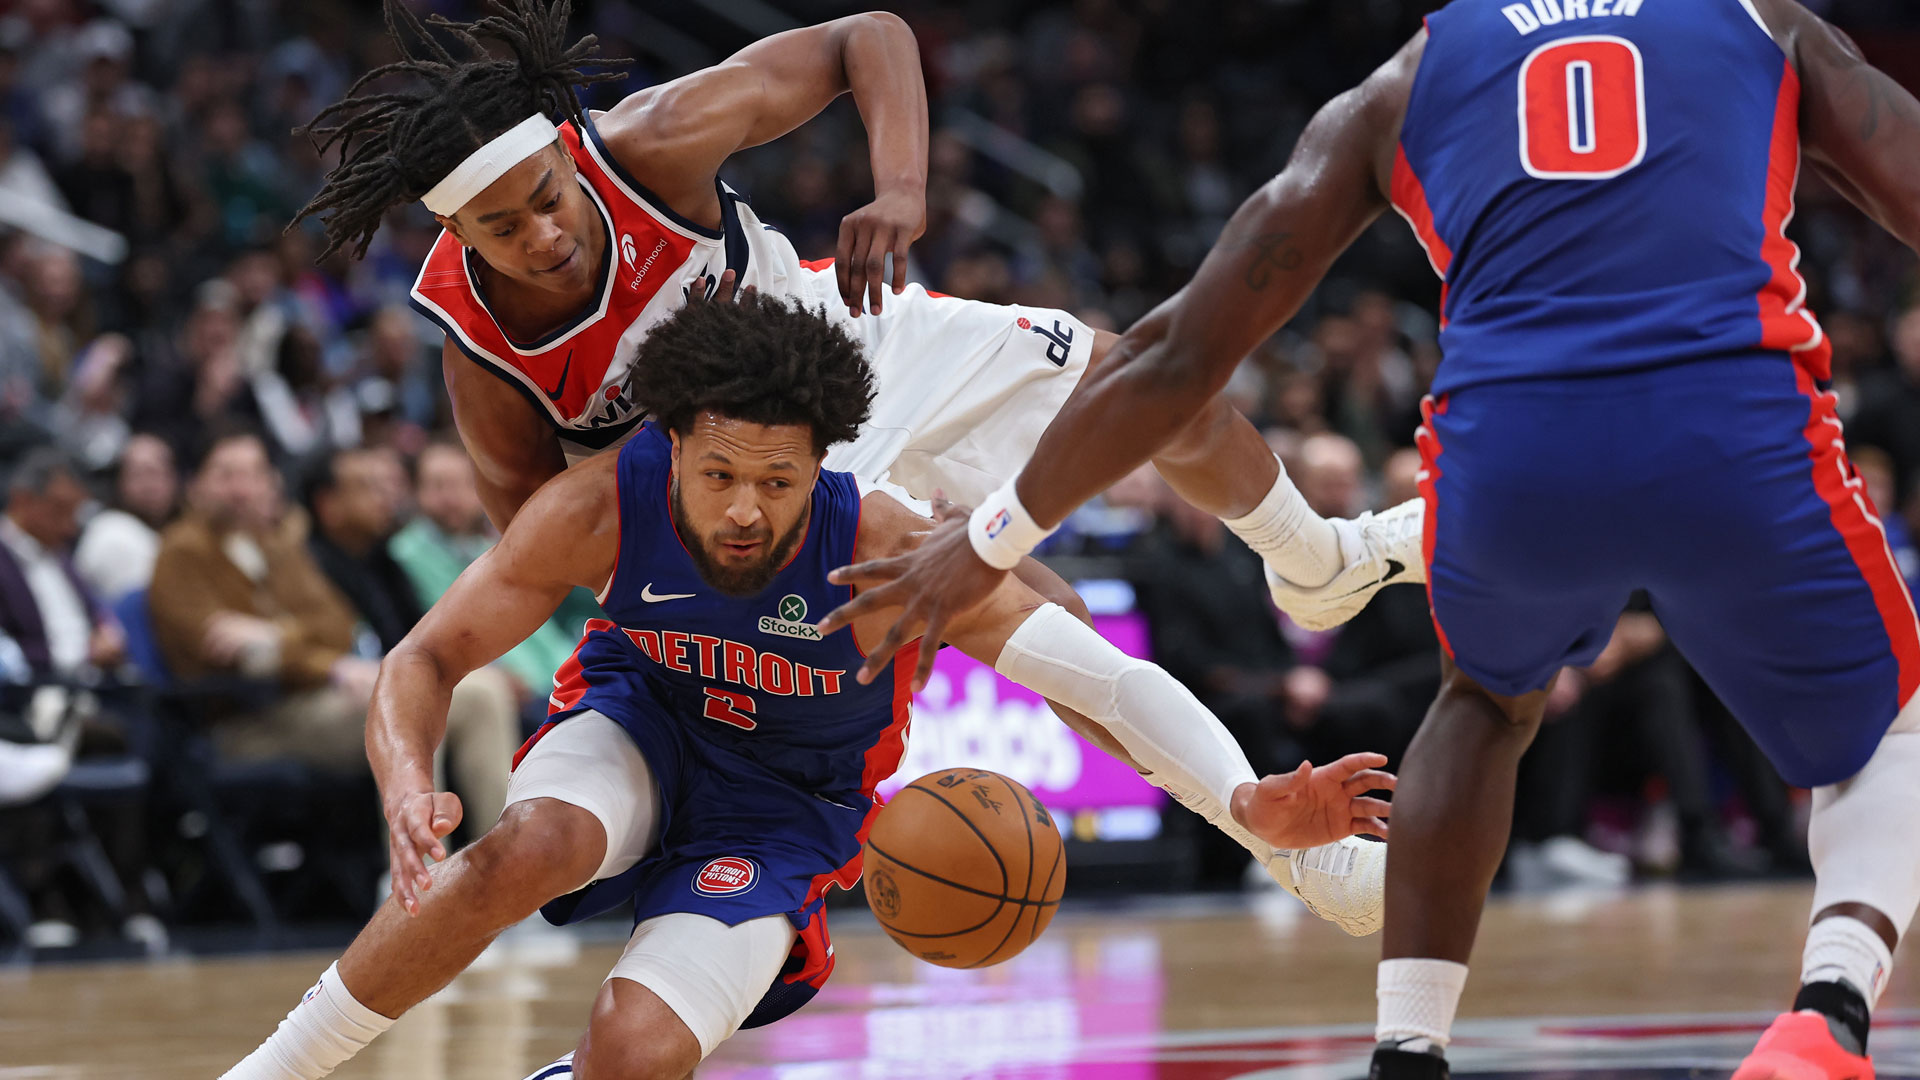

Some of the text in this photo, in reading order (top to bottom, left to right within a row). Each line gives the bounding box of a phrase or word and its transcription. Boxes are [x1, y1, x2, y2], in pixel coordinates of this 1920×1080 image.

[1517, 34, 1648, 181] 0
[630, 238, 668, 291] Robinhood
[760, 617, 820, 639] StockX
[621, 627, 847, 697] DETROIT
[703, 686, 757, 731] 2
[703, 871, 742, 886] PISTONS
[710, 864, 747, 879] DETROIT
